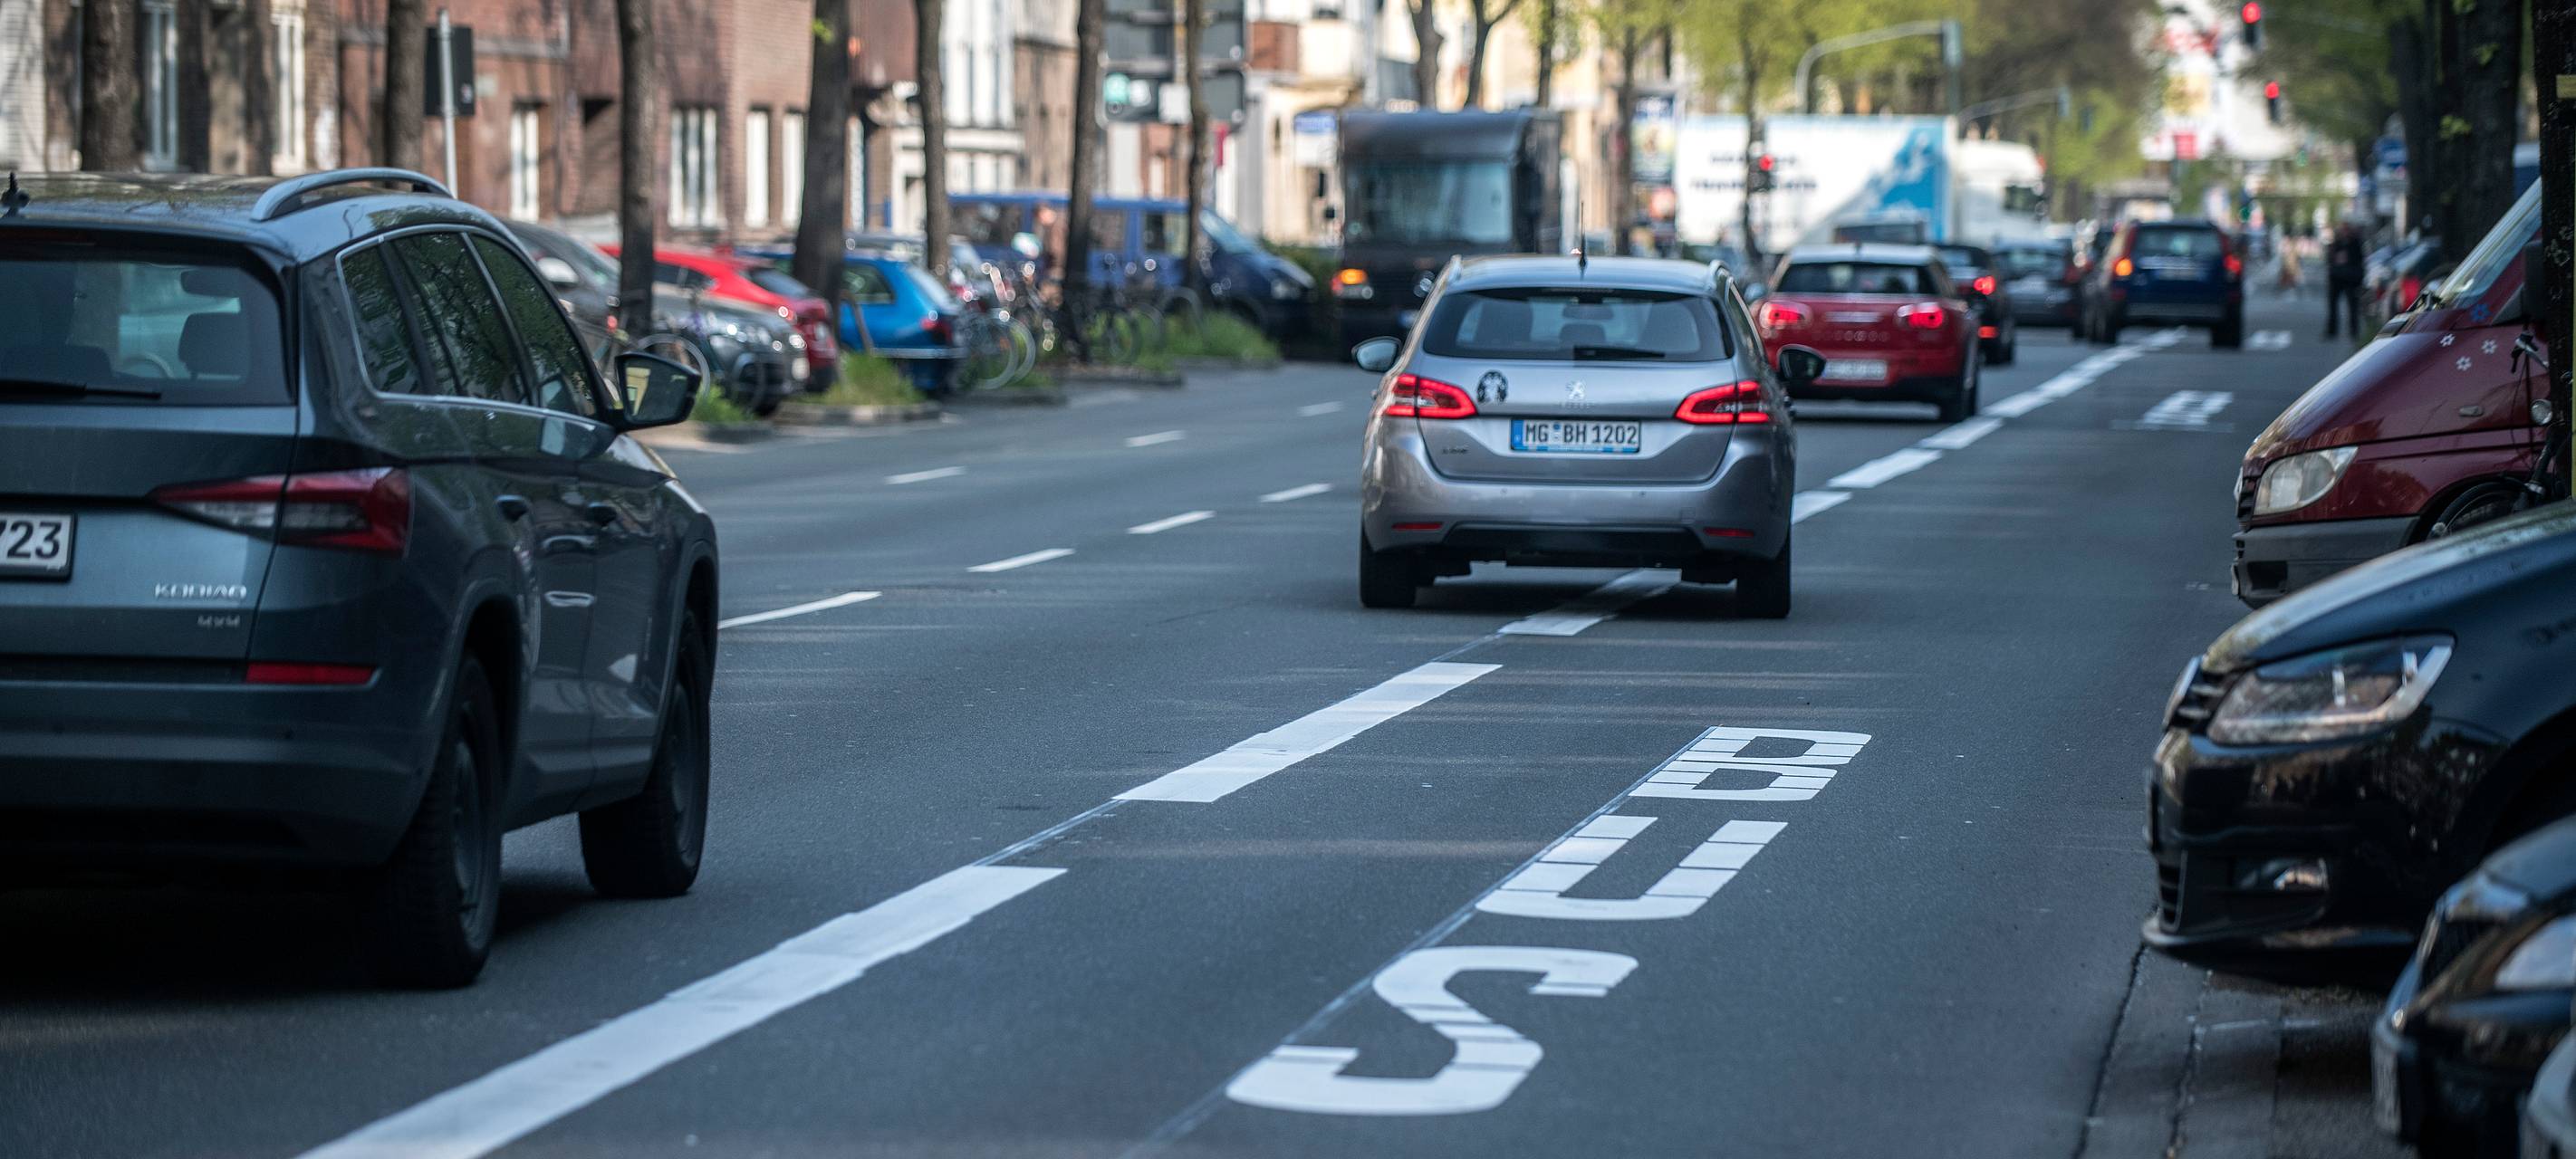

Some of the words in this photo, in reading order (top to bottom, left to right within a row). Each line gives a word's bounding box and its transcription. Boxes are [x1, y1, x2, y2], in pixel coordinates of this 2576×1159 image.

[1525, 424, 1548, 443] MG
[1563, 425, 1586, 444] BH
[1591, 426, 1637, 445] 1202
[0, 520, 62, 560] 23
[1226, 726, 1871, 1115] BUS
